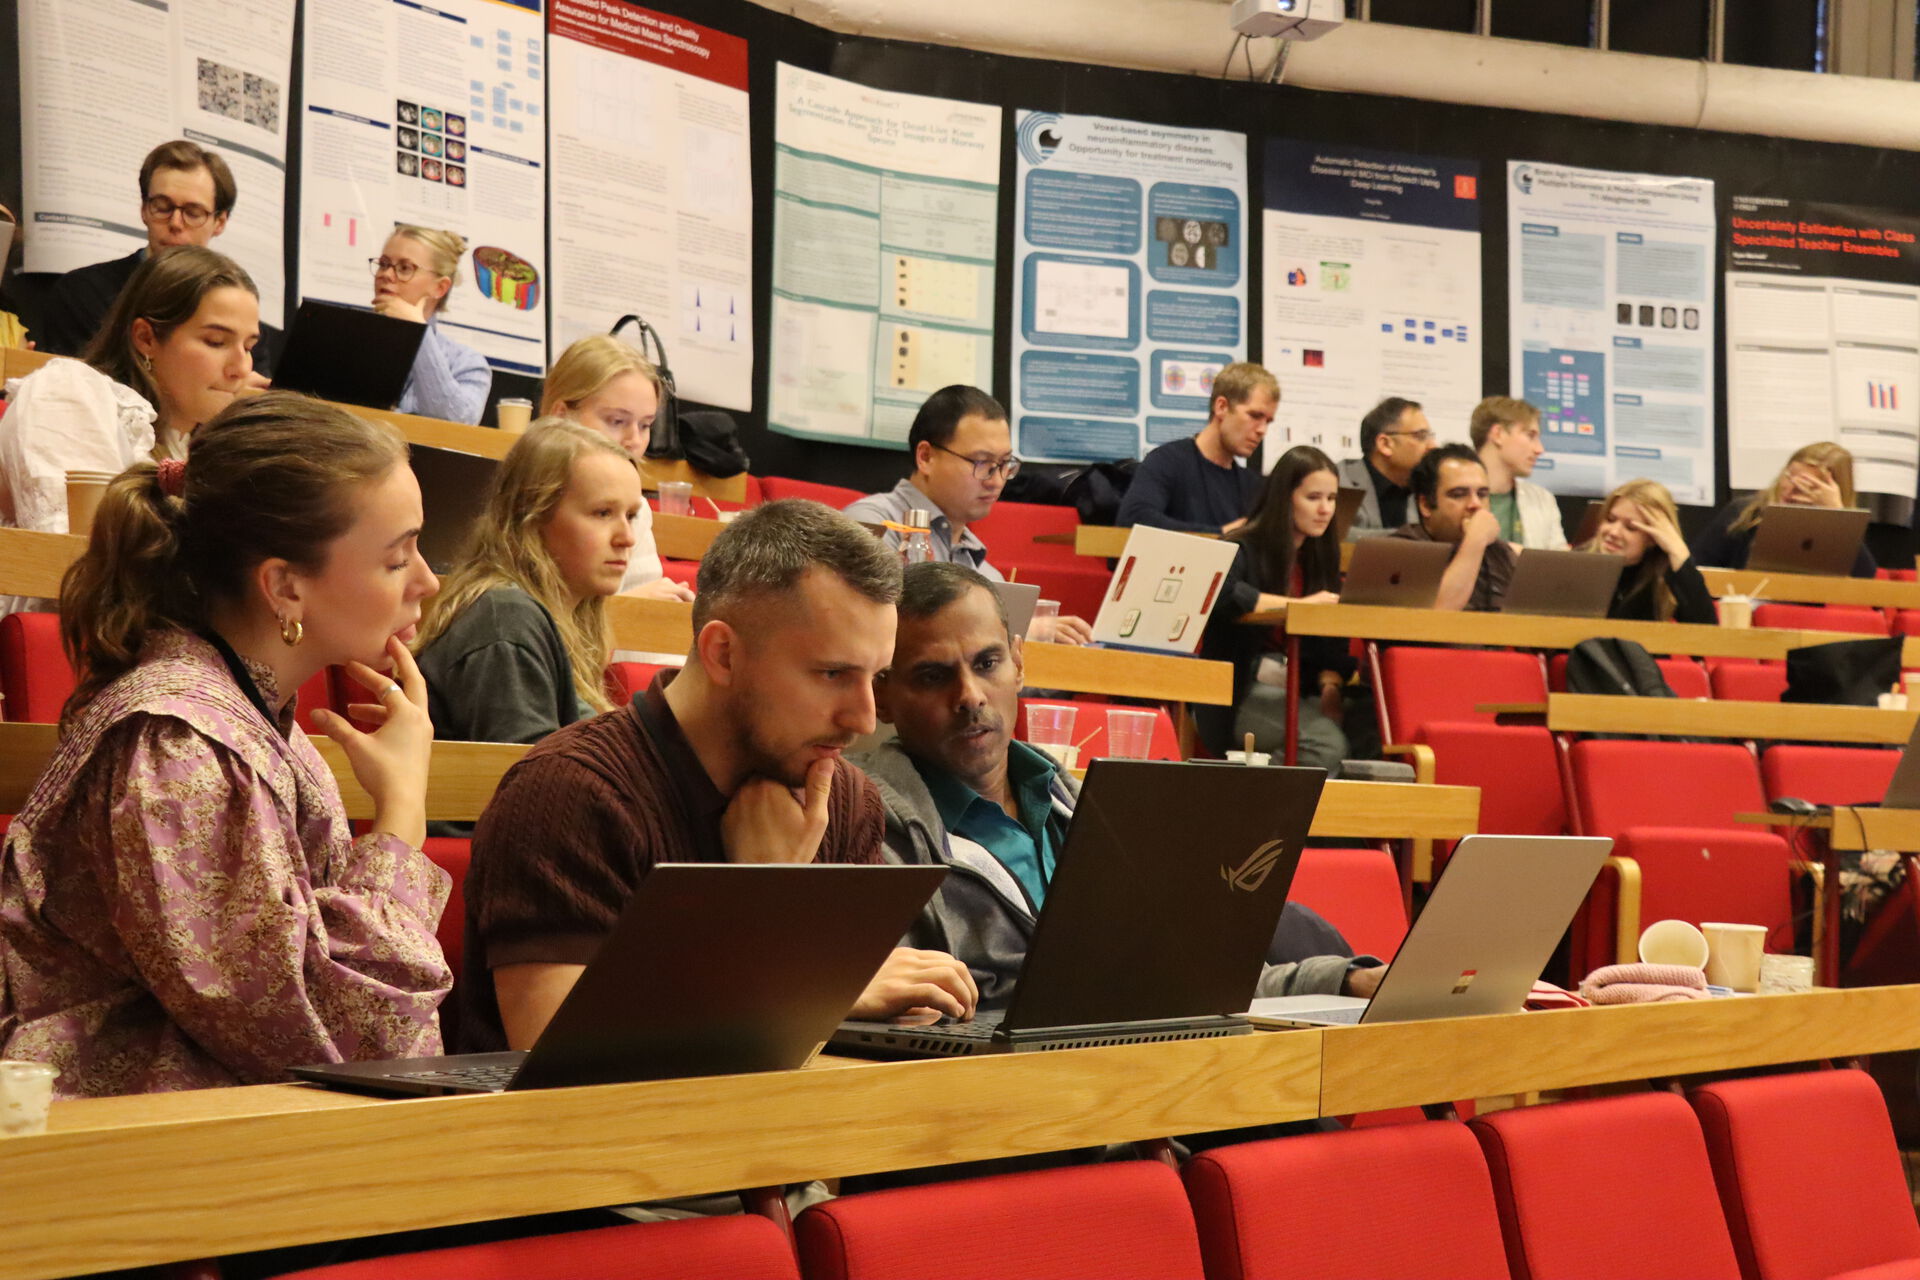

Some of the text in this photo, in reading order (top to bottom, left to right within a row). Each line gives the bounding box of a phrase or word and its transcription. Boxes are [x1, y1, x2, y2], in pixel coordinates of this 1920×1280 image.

[555, 1, 597, 22] Assurance
[597, 13, 610, 25] for
[610, 17, 641, 35] Medical
[642, 26, 662, 41] Mass
[663, 33, 710, 59] Spectroscopy
[600, 1, 621, 15] Peak
[622, 8, 658, 28] Detection
[659, 21, 674, 32] and
[674, 24, 700, 42] Quality
[844, 108, 883, 125] Approach
[886, 118, 898, 129] for
[1093, 122, 1211, 143] Voxel-based asymmetry in
[1087, 135, 1172, 152] neuroinflammatory
[1069, 143, 1122, 158] Opportunity
[1125, 149, 1138, 158] for
[1140, 151, 1184, 162] treatment
[1185, 158, 1233, 171] monitoring
[1354, 159, 1388, 171] Detection
[1310, 164, 1342, 176] Disease
[1343, 168, 1358, 177] and
[1732, 216, 1796, 235] Uncertainty
[1798, 221, 1857, 237] Estimation
[1858, 228, 1882, 240] with
[1883, 229, 1915, 243] Class
[1797, 237, 1841, 251] Teacher
[1842, 240, 1899, 258] Ensembles
